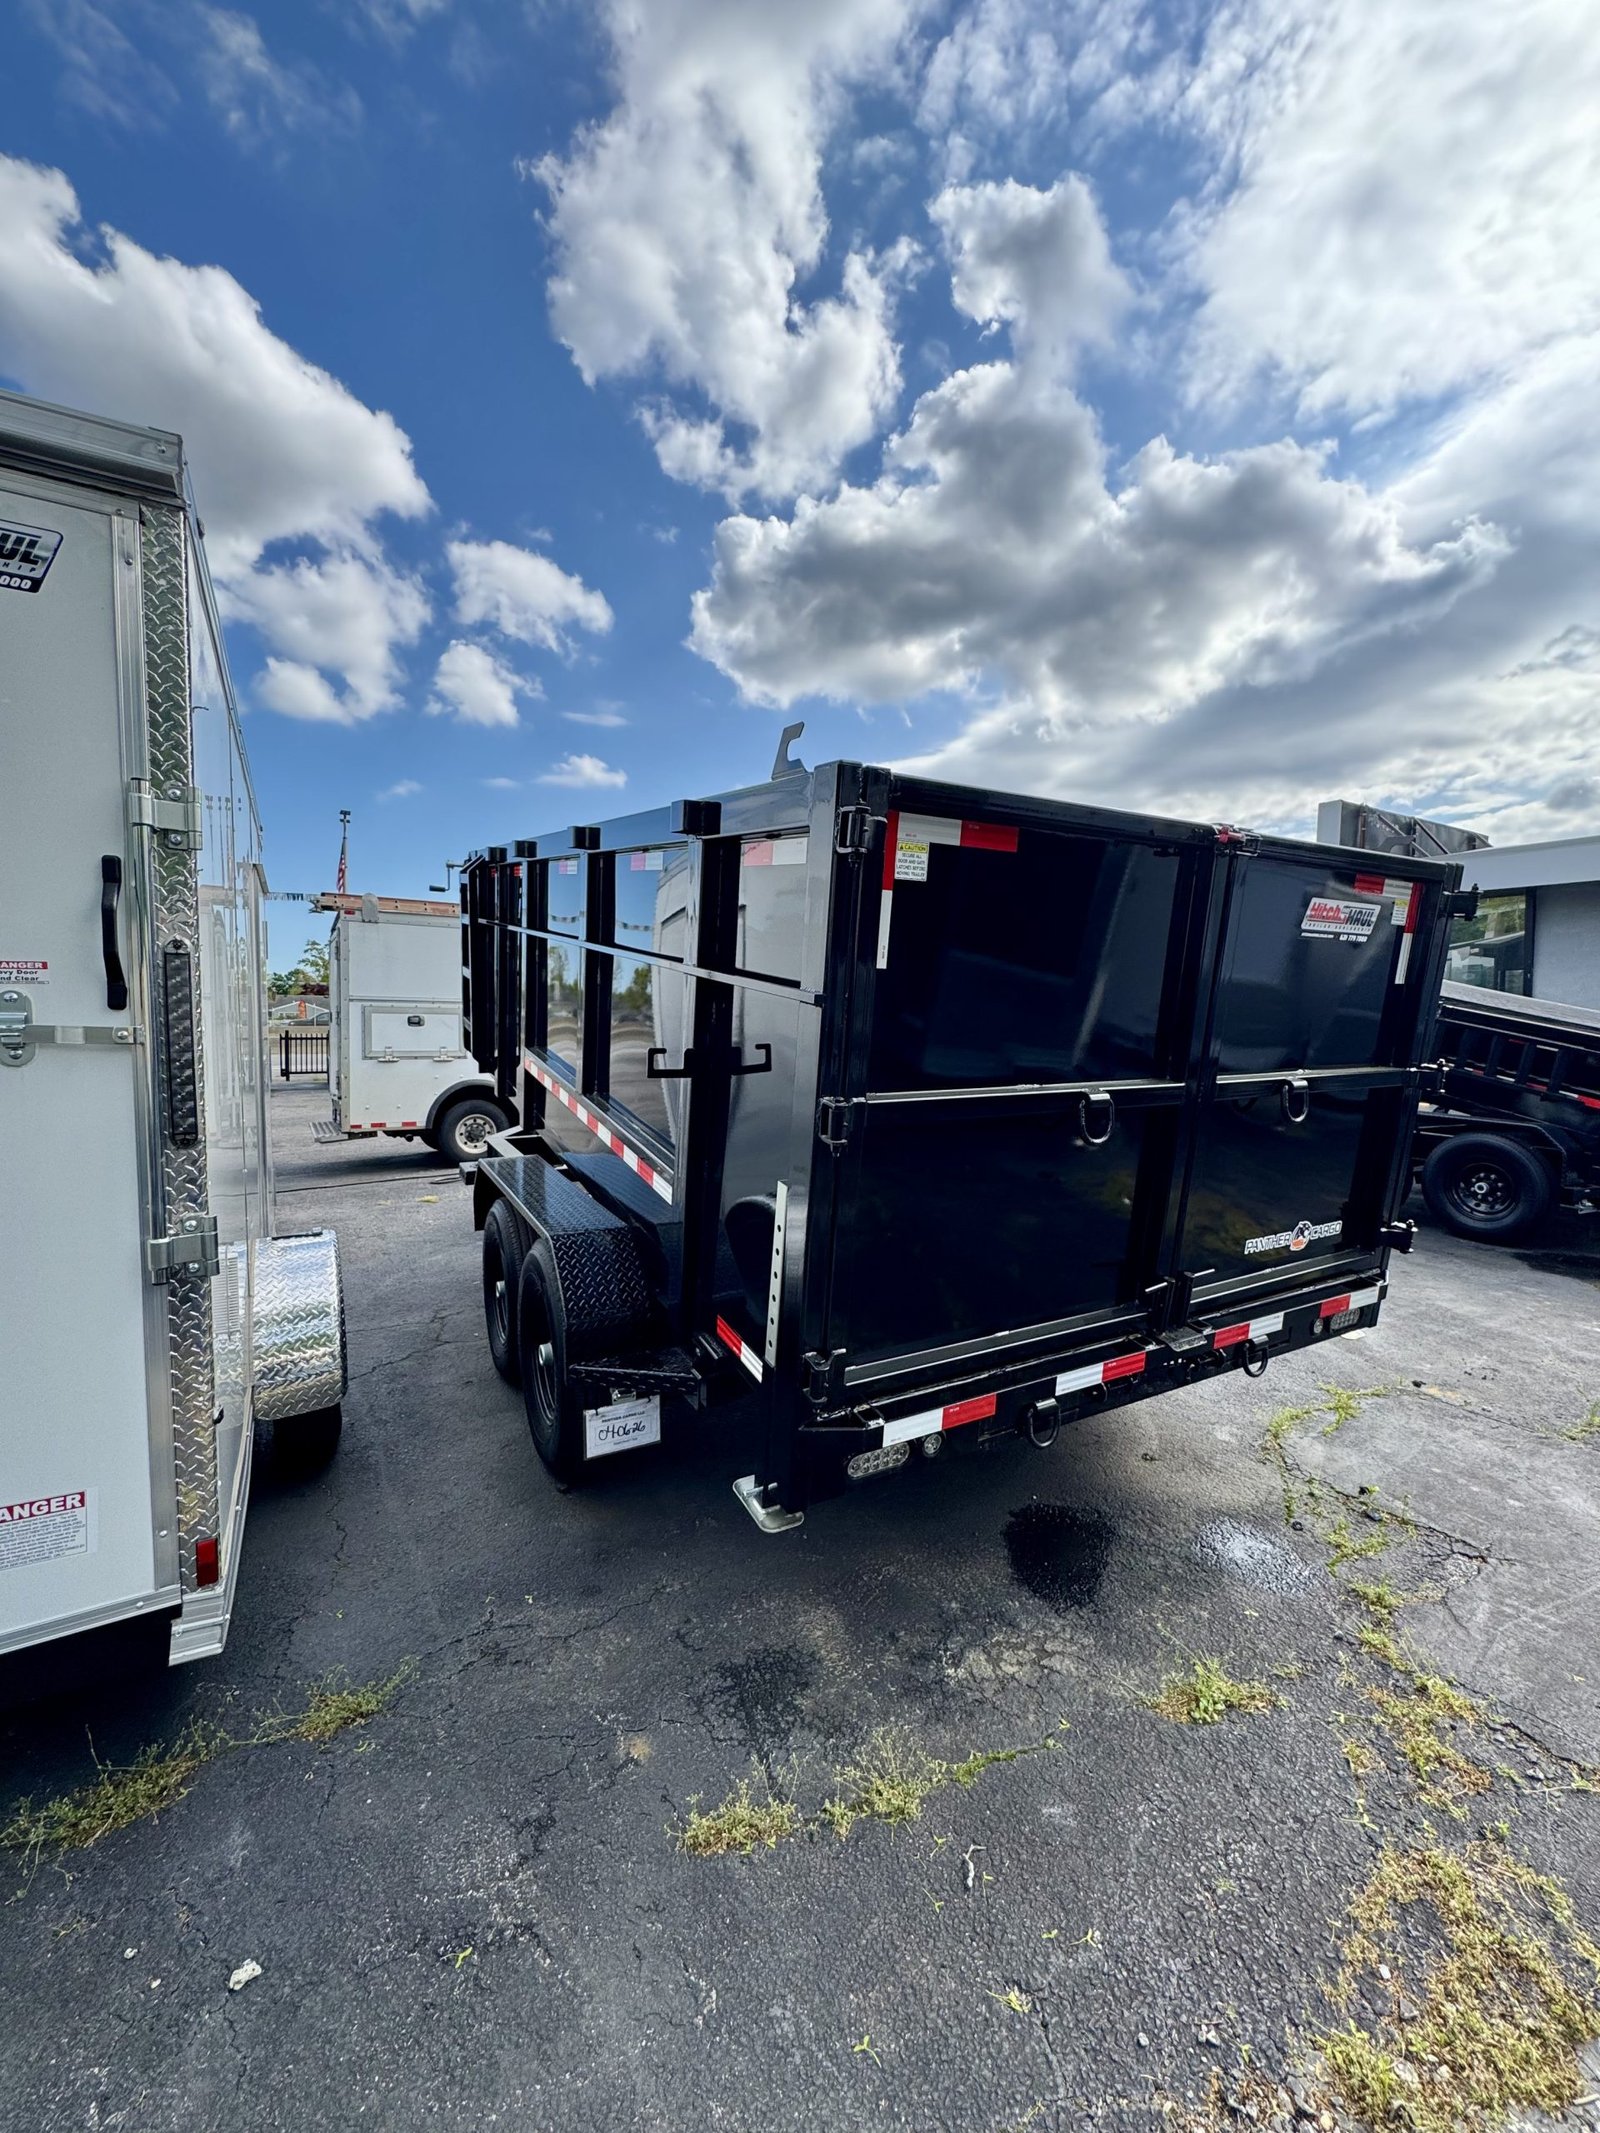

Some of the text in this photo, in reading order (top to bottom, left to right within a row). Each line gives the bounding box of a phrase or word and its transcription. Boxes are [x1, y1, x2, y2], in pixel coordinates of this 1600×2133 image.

[903, 844, 926, 852] CAUTION
[1345, 908, 1375, 927] HAUL
[1244, 1221, 1342, 1255] PANTHER CARGO
